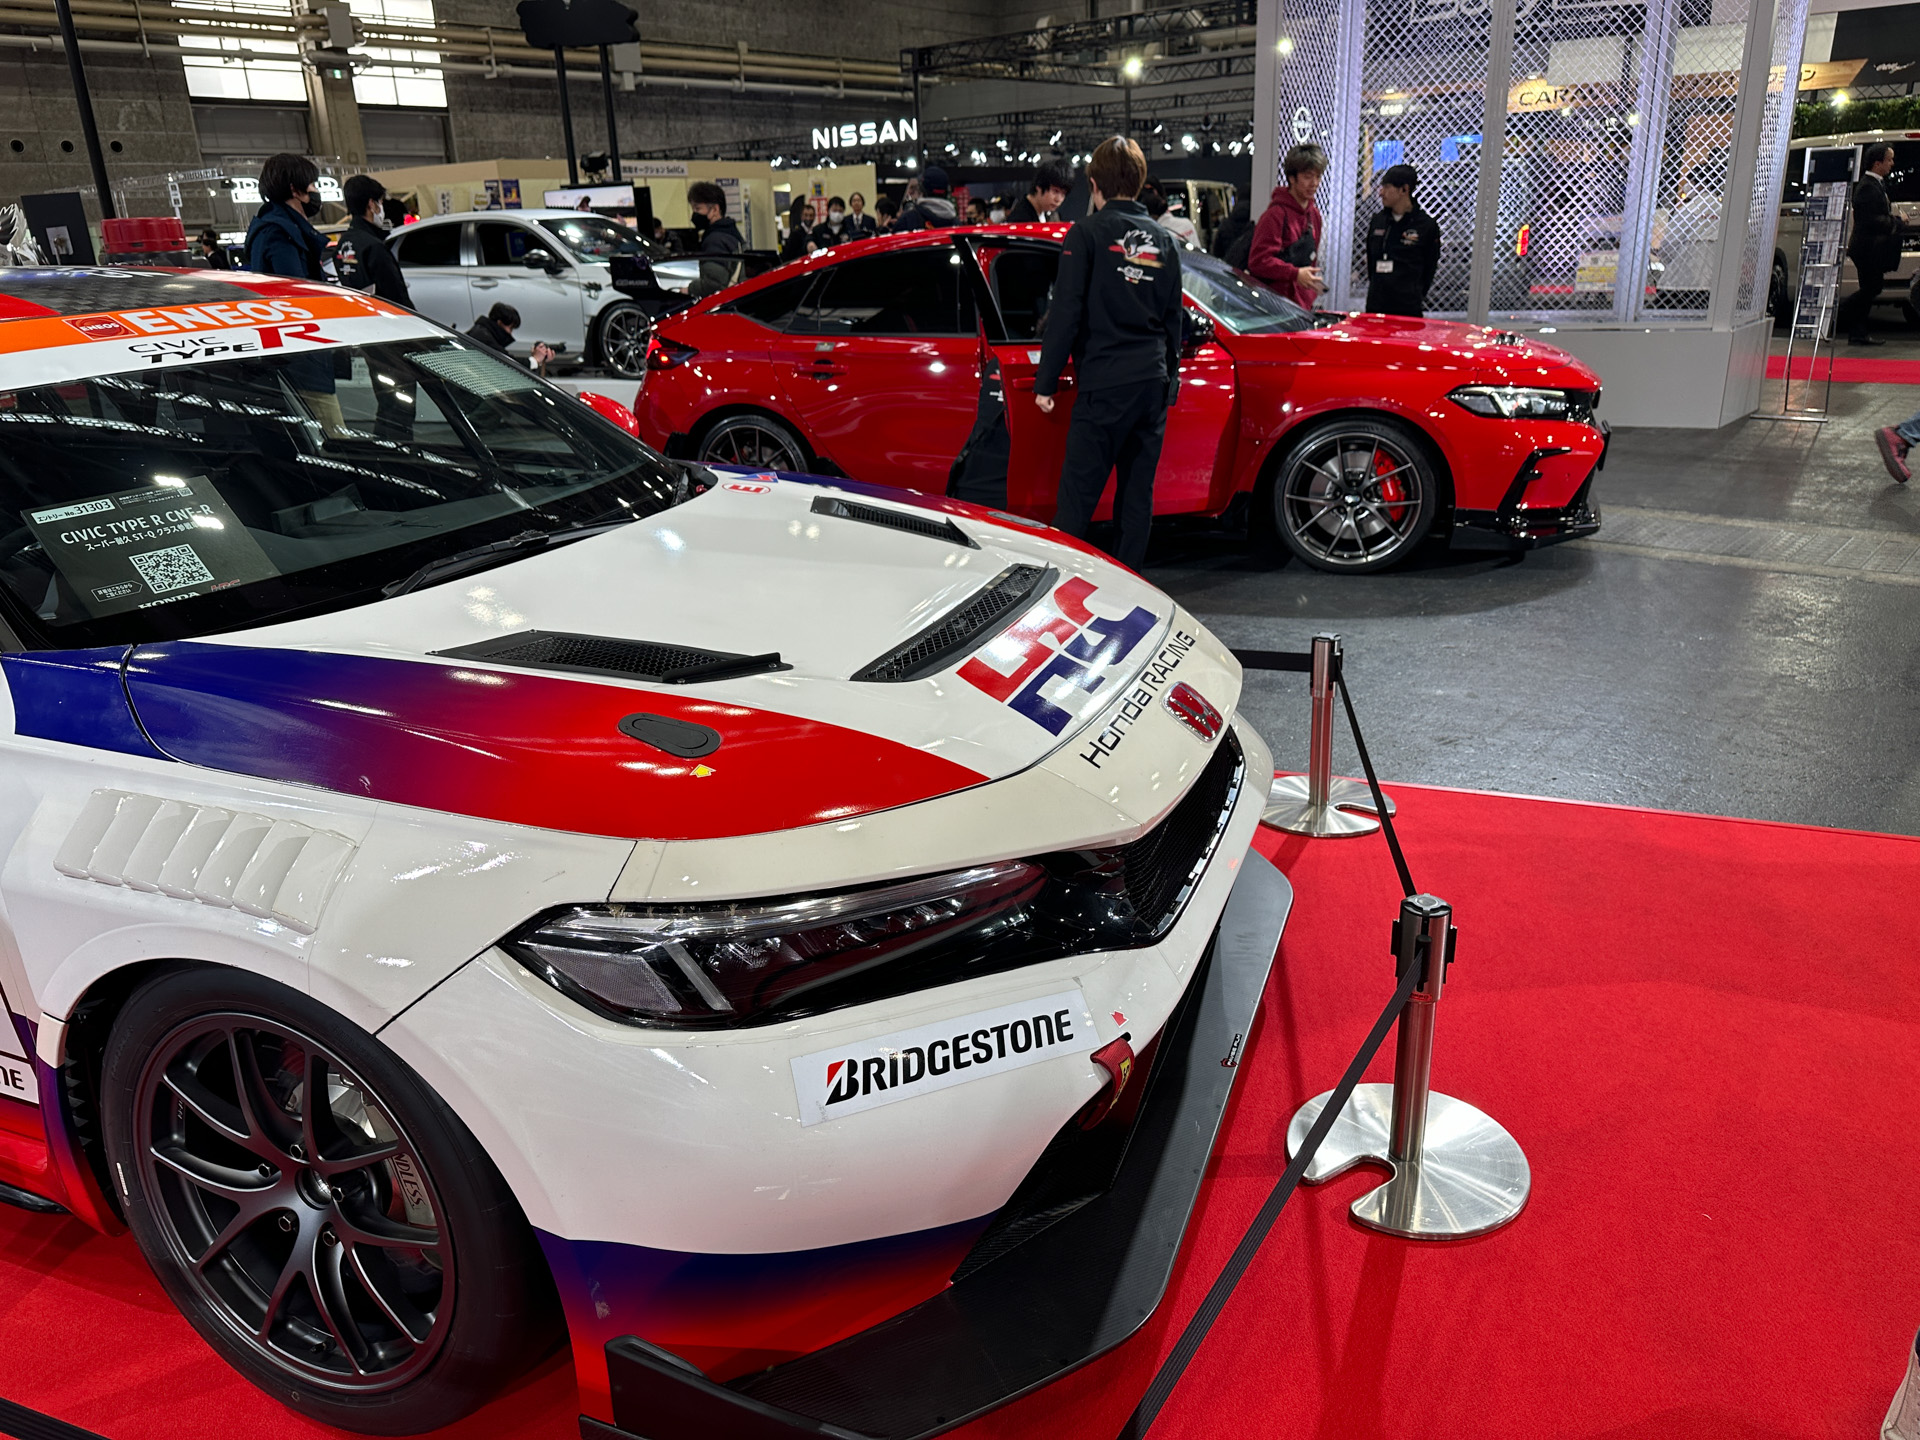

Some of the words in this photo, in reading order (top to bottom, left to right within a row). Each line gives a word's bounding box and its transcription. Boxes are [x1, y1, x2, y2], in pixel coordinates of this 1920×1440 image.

[812, 118, 918, 150] NISSAN
[79, 321, 120, 334] ENEOS
[120, 300, 313, 333] ENEOS
[129, 336, 226, 353] CIVIC
[141, 342, 260, 364] TYPE
[252, 322, 344, 349] R
[37, 513, 64, 523] エントリー
[60, 524, 107, 546] CIVIC
[106, 515, 149, 537] TYPE
[151, 511, 165, 527] R
[85, 535, 132, 552] スーパー耐久
[132, 529, 157, 543] ST-Q
[138, 591, 201, 609] HONDA
[1079, 683, 1153, 769] Honda
[1146, 630, 1196, 693] RACING
[824, 1008, 1074, 1106] BRIDGESTONE
